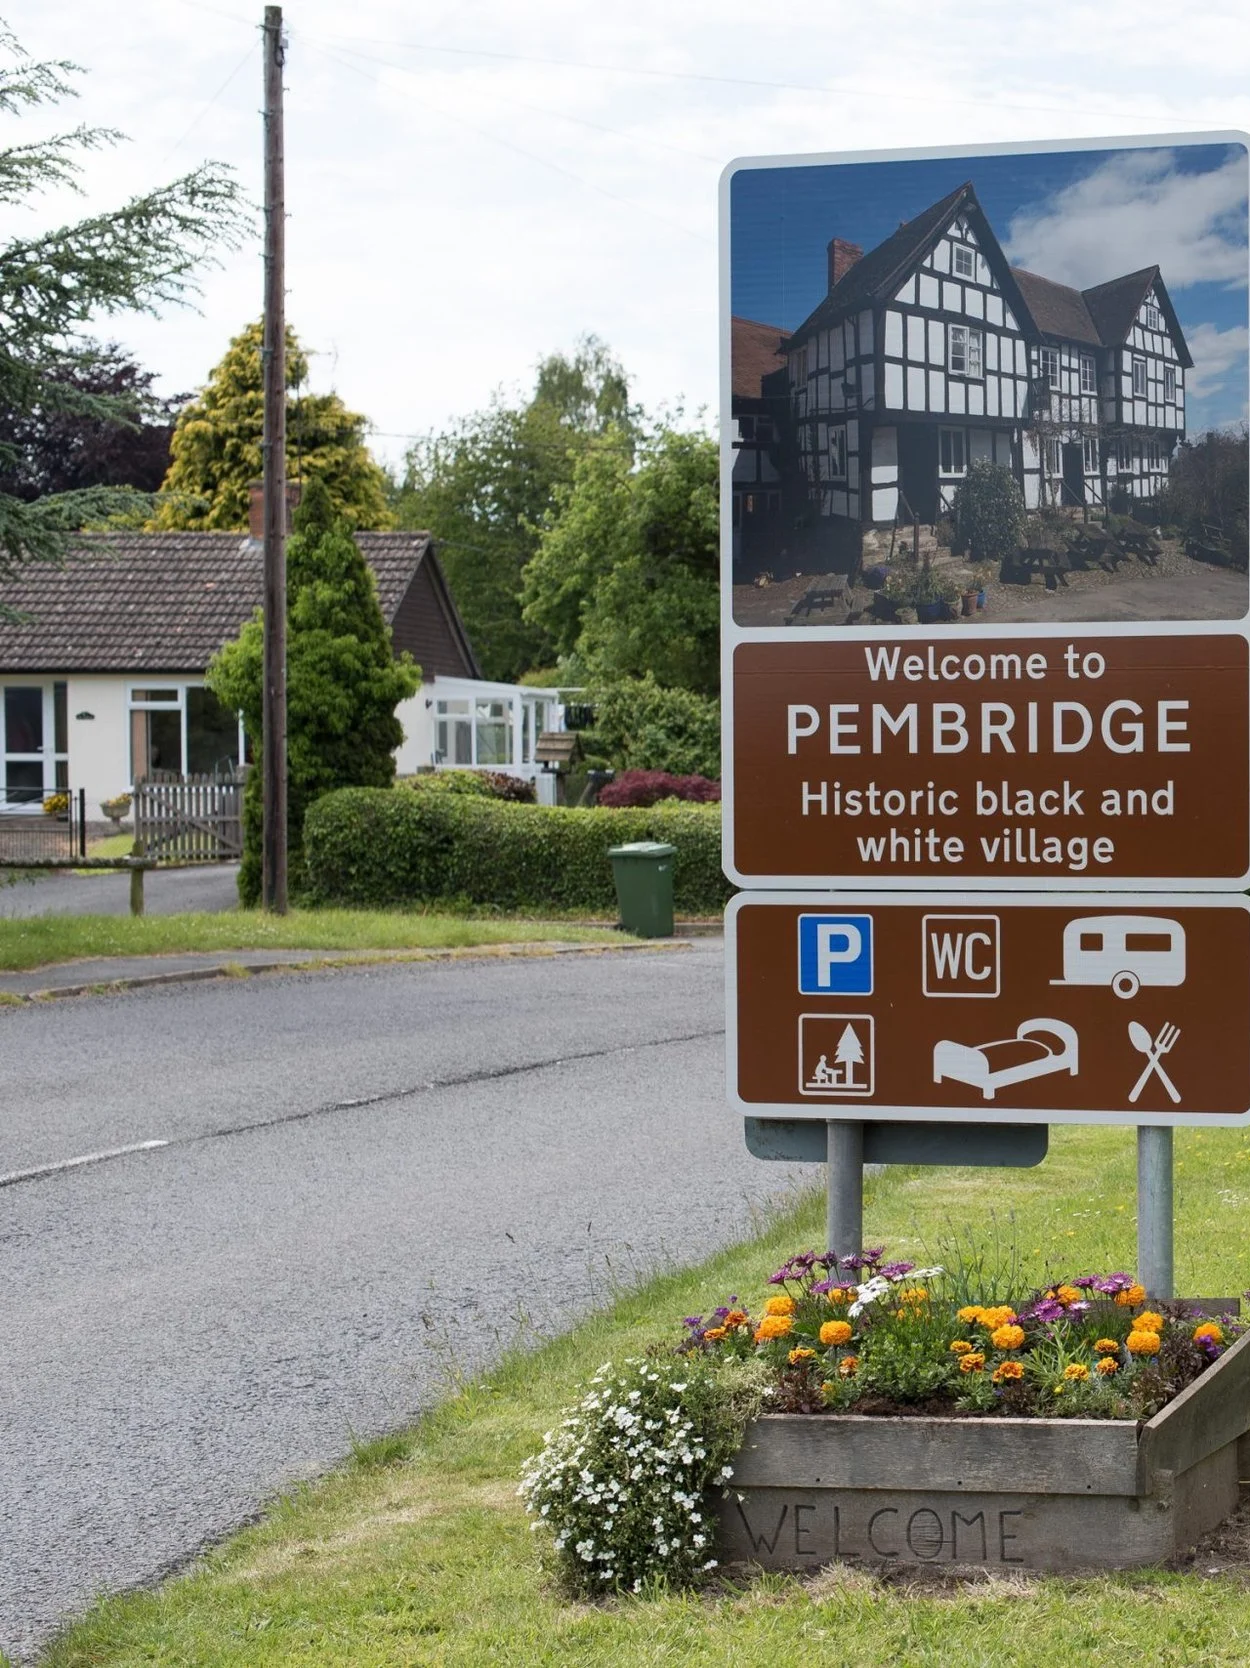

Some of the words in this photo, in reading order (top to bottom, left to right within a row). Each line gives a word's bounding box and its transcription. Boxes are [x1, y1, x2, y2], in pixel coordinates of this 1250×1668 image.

[864, 645, 1048, 681] Welcome
[1063, 644, 1106, 680] to
[787, 699, 1191, 755] PEMBRIDGE
[802, 780, 958, 816] Historic
[976, 780, 1084, 816] black
[1101, 780, 1175, 816] and
[857, 828, 964, 863] white
[981, 827, 1115, 871] village
[816, 923, 862, 988] P
[931, 932, 992, 980] WC
[735, 1502, 1025, 1563] WELCOME
